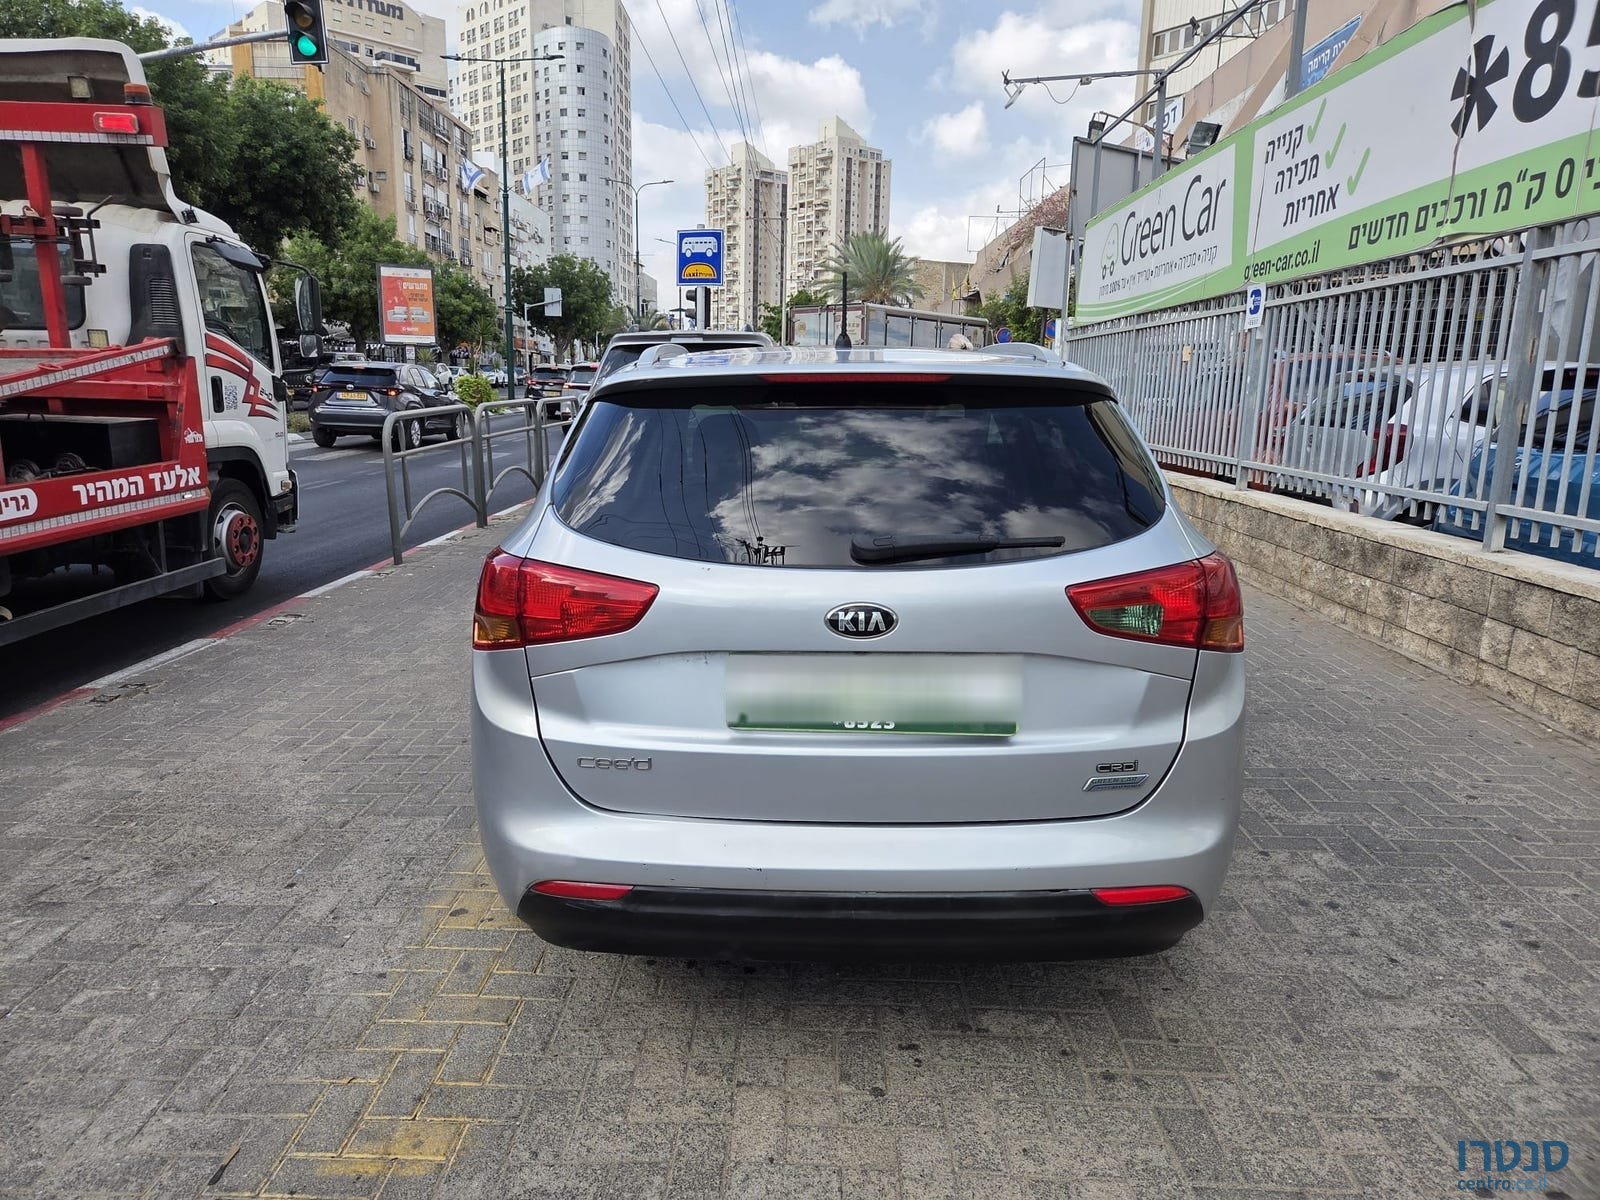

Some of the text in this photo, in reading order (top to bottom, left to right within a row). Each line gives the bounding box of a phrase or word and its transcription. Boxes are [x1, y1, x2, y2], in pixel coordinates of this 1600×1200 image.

[1307, 49, 1331, 73] קדימה
[1265, 124, 1304, 164] קנייה
[1274, 153, 1319, 194] מכירה
[1121, 174, 1227, 266] Green Car
[1283, 183, 1340, 227] אחריות
[1414, 188, 1487, 233] ורכבים
[1348, 212, 1409, 250] חדשים
[1153, 262, 1174, 279] אחריות
[1178, 252, 1197, 272] מכירה
[1201, 245, 1218, 265] קניה
[72, 464, 201, 505] אלעד המהיר
[838, 612, 886, 631] KIA
